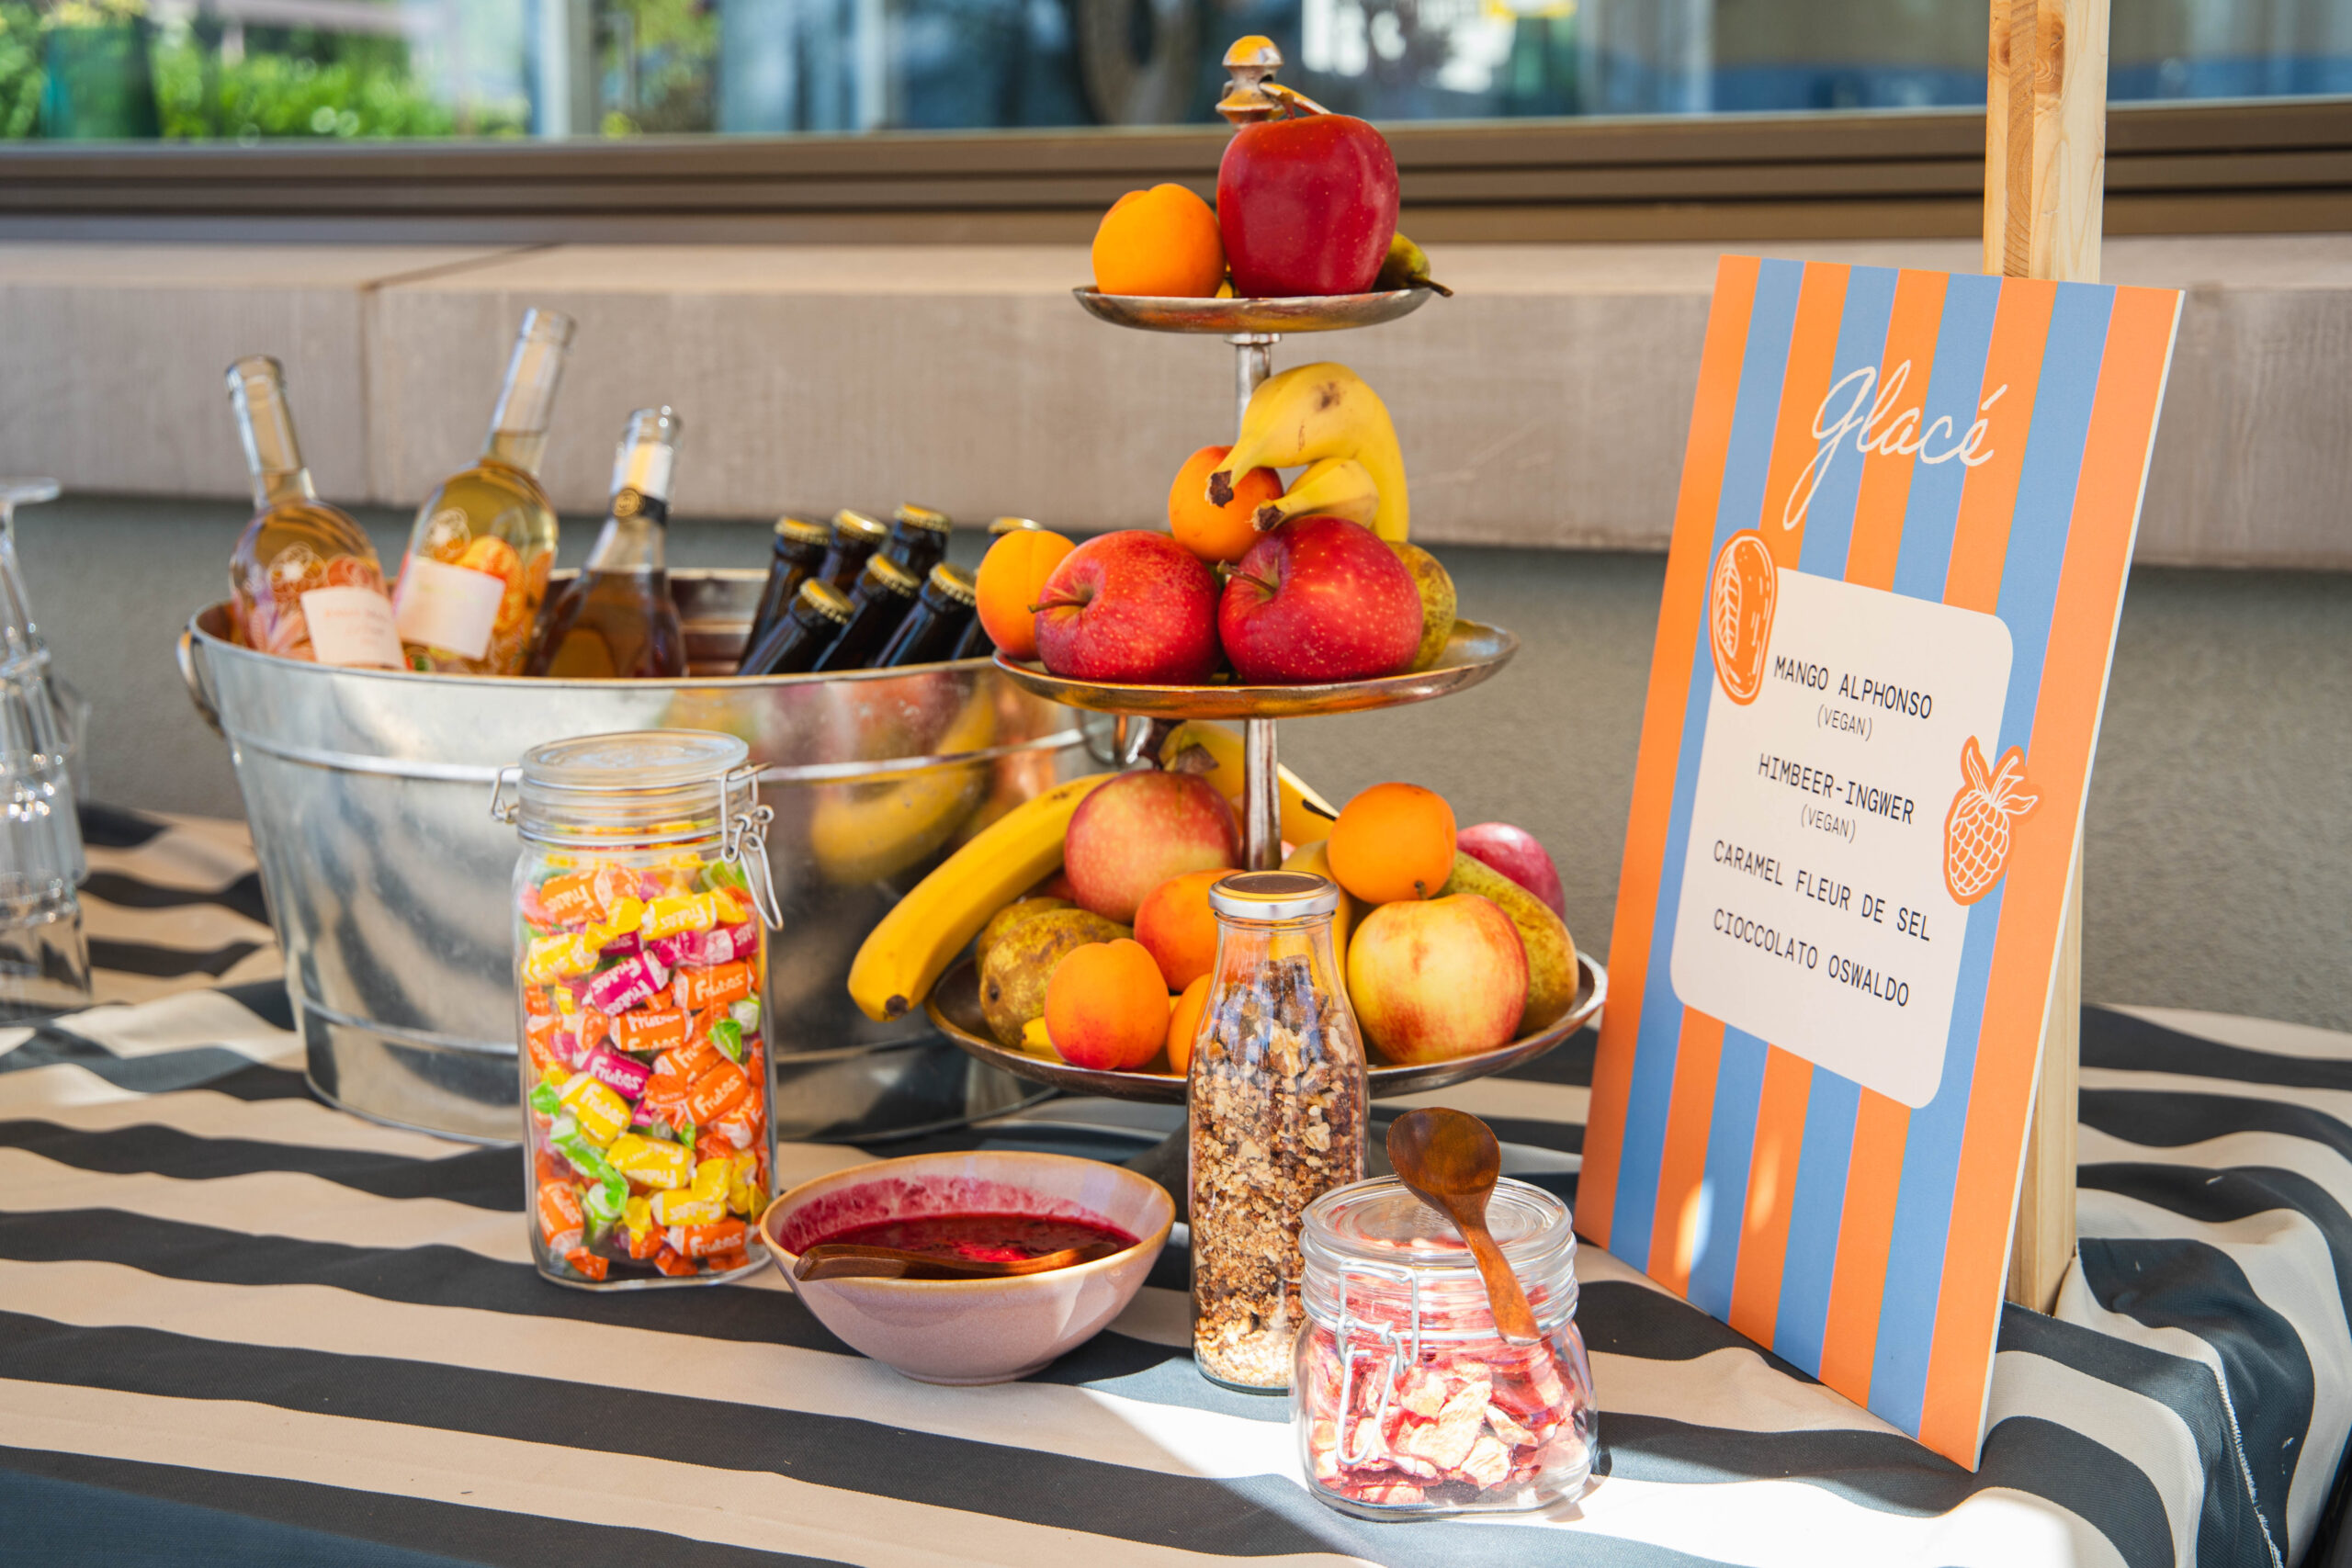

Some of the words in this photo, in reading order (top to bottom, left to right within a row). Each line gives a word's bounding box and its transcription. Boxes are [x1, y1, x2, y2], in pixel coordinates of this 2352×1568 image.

[1773, 655, 1829, 691] MANGO
[1838, 673, 1933, 719] ALPHONSO
[1817, 704, 1873, 742] (VEGAN)
[1758, 752, 1915, 825] HIMBEER-INGWER
[1801, 804, 1856, 844] (VEGAN)
[1713, 840, 1783, 886] CARAMEL
[1795, 869, 1851, 911] FLEUR
[1861, 893, 1886, 924] DE
[1896, 907, 1931, 942] SEL
[1713, 908, 1818, 970] CIOCCOLATO
[1828, 954, 1910, 1008] OSWALDO
